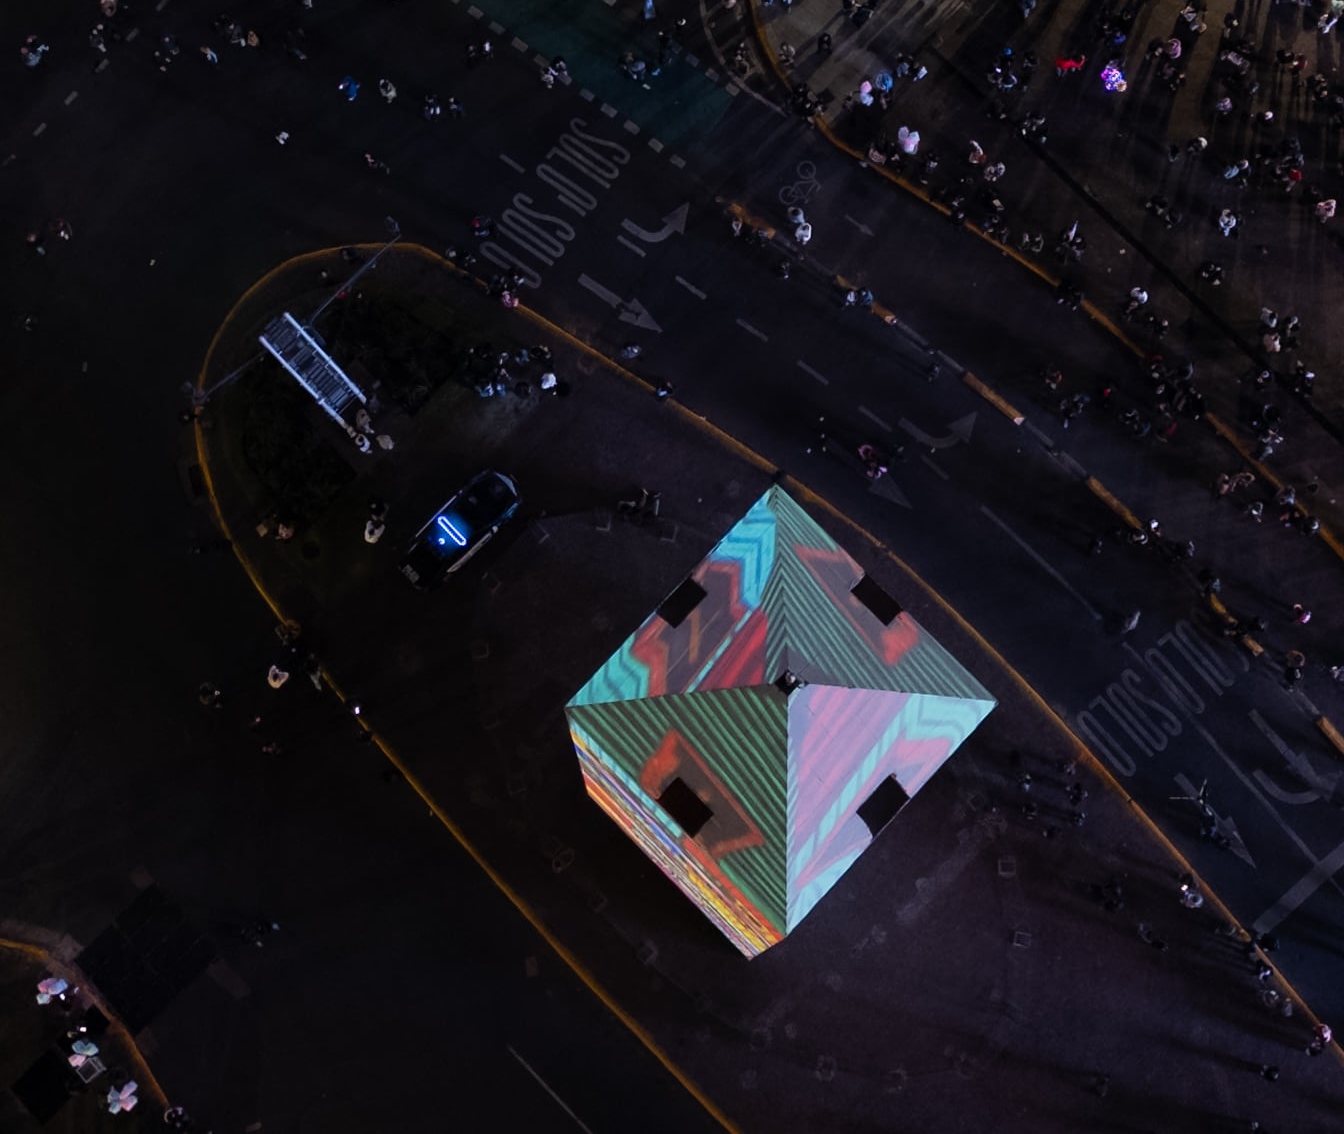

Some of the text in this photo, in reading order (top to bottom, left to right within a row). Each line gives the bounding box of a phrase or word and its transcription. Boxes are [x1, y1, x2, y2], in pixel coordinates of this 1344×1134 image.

[536, 116, 631, 211] SOLO
[479, 192, 576, 289] SOLO
[1076, 668, 1183, 778] SOLO
